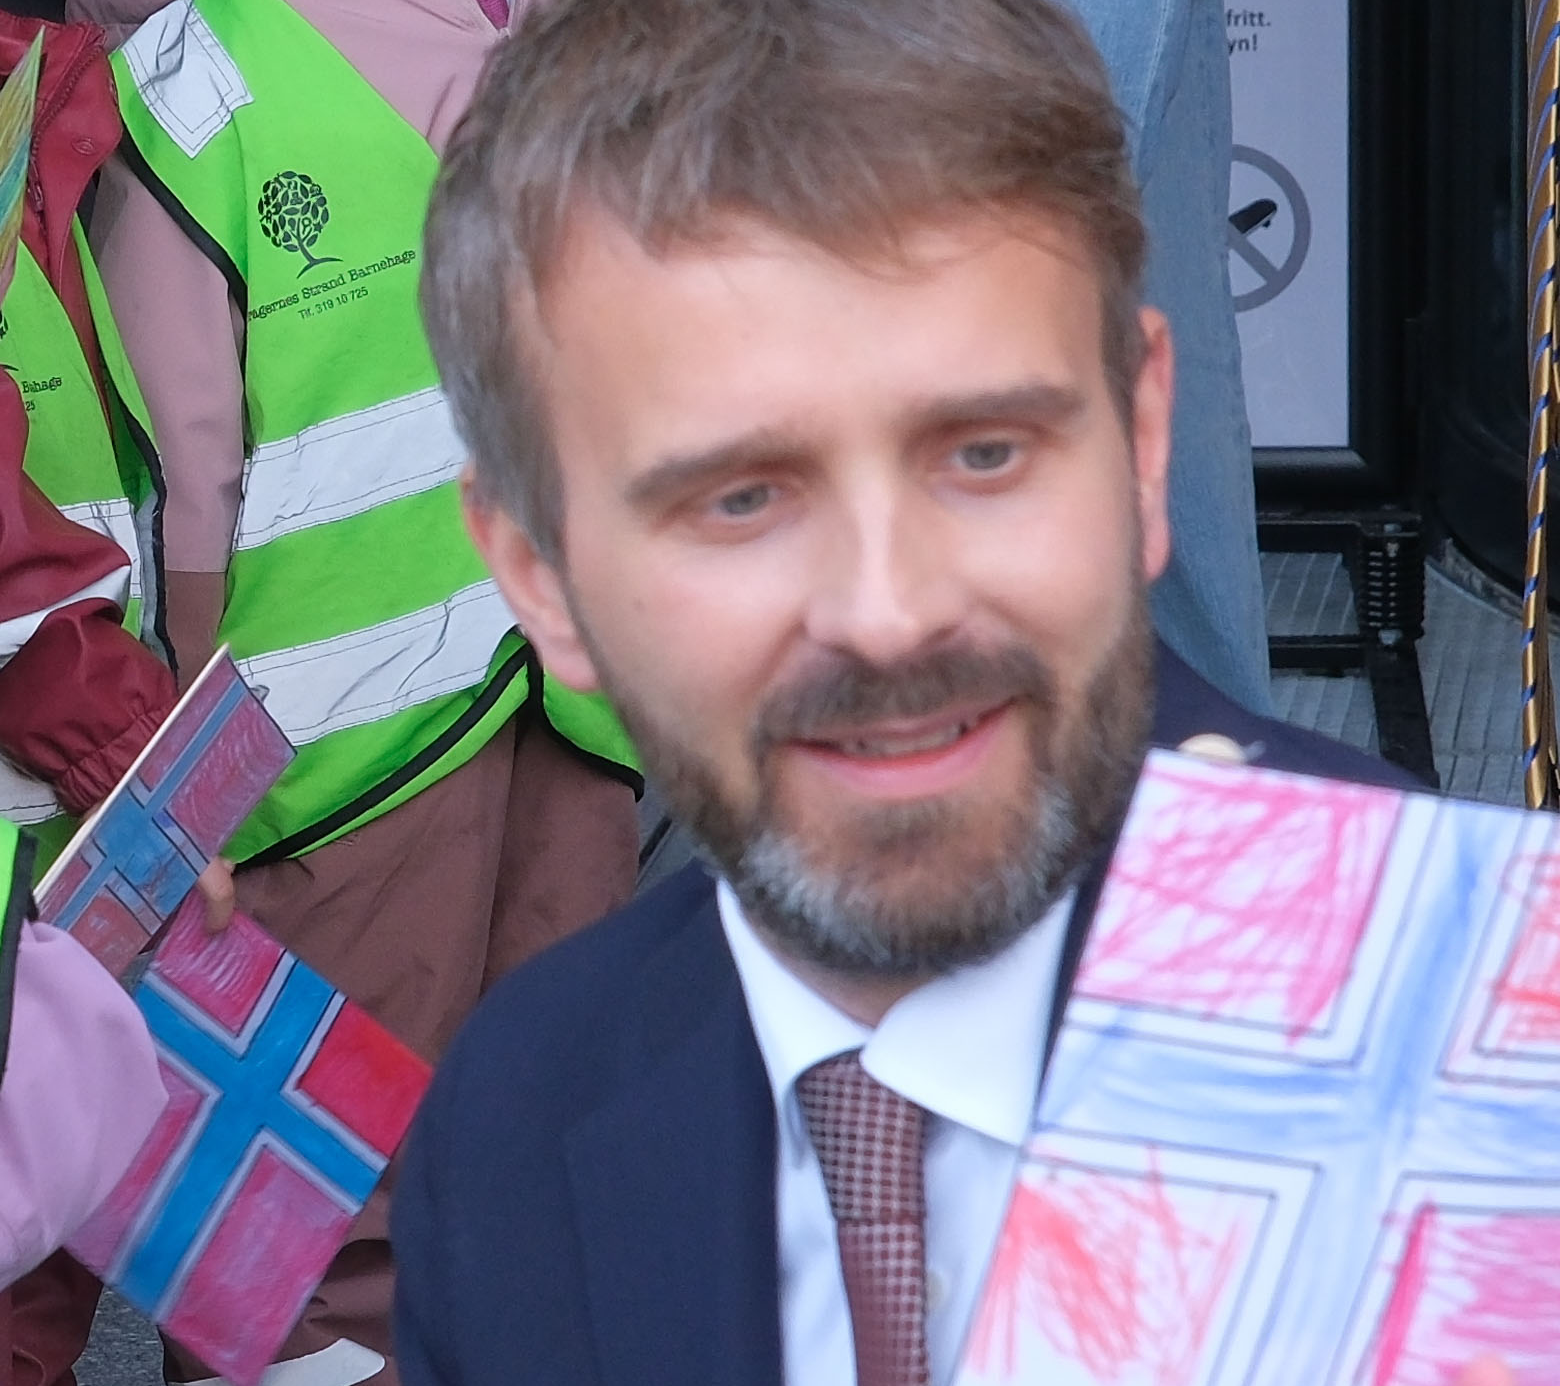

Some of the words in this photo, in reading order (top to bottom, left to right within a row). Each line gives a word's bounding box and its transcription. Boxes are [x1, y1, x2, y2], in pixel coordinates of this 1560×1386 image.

[1226, 8, 1272, 28] fritt.
[301, 273, 347, 300] Strand
[348, 249, 417, 282] Barnehage
[316, 298, 335, 315] 319
[336, 293, 348, 306] 10
[349, 286, 369, 301] 725
